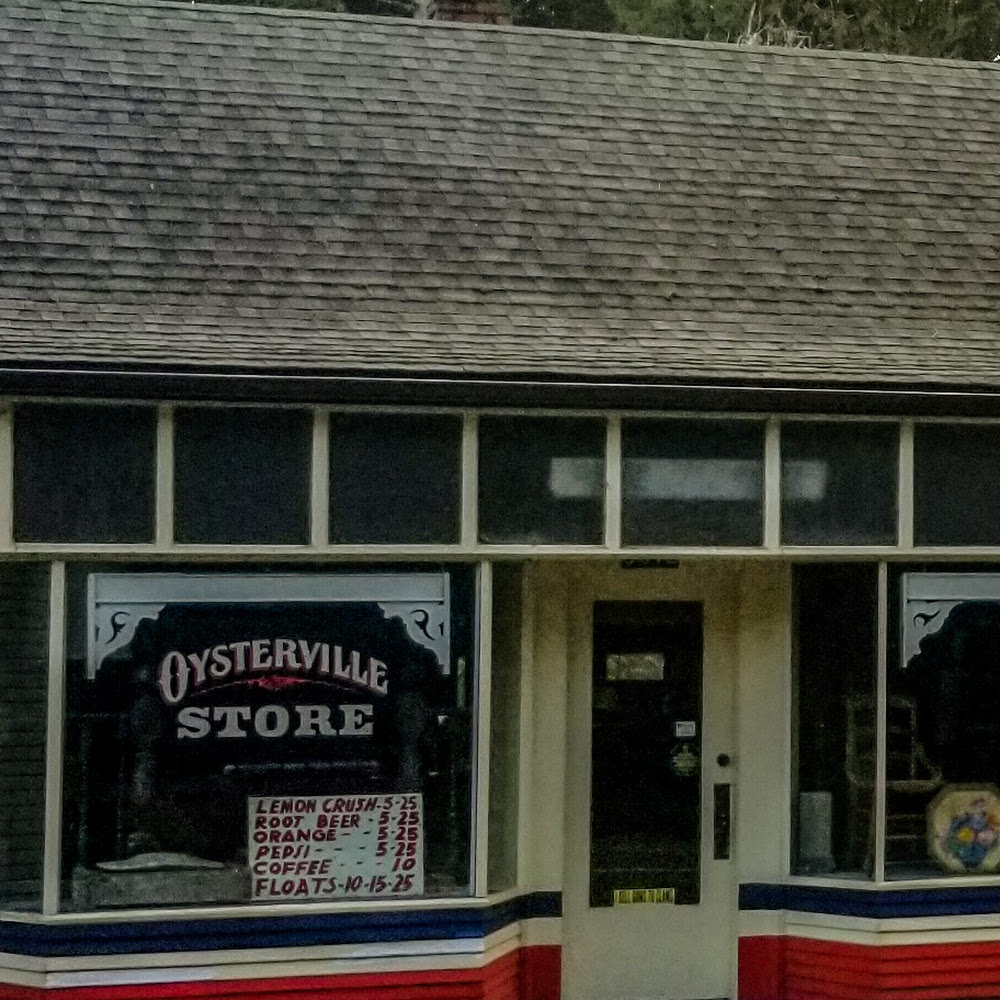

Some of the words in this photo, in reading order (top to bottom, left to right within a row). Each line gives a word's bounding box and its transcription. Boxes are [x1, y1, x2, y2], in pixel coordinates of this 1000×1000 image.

[158, 638, 388, 702] OYSTERVILLE
[177, 704, 374, 738] STORE
[256, 799, 317, 814] LEMON
[255, 815, 305, 829] ROOT
[316, 813, 361, 828] BEER
[253, 829, 337, 843] ORANGE
[255, 845, 310, 860] PEPSI
[253, 859, 332, 875] COFFEE
[392, 858, 416, 872] 10
